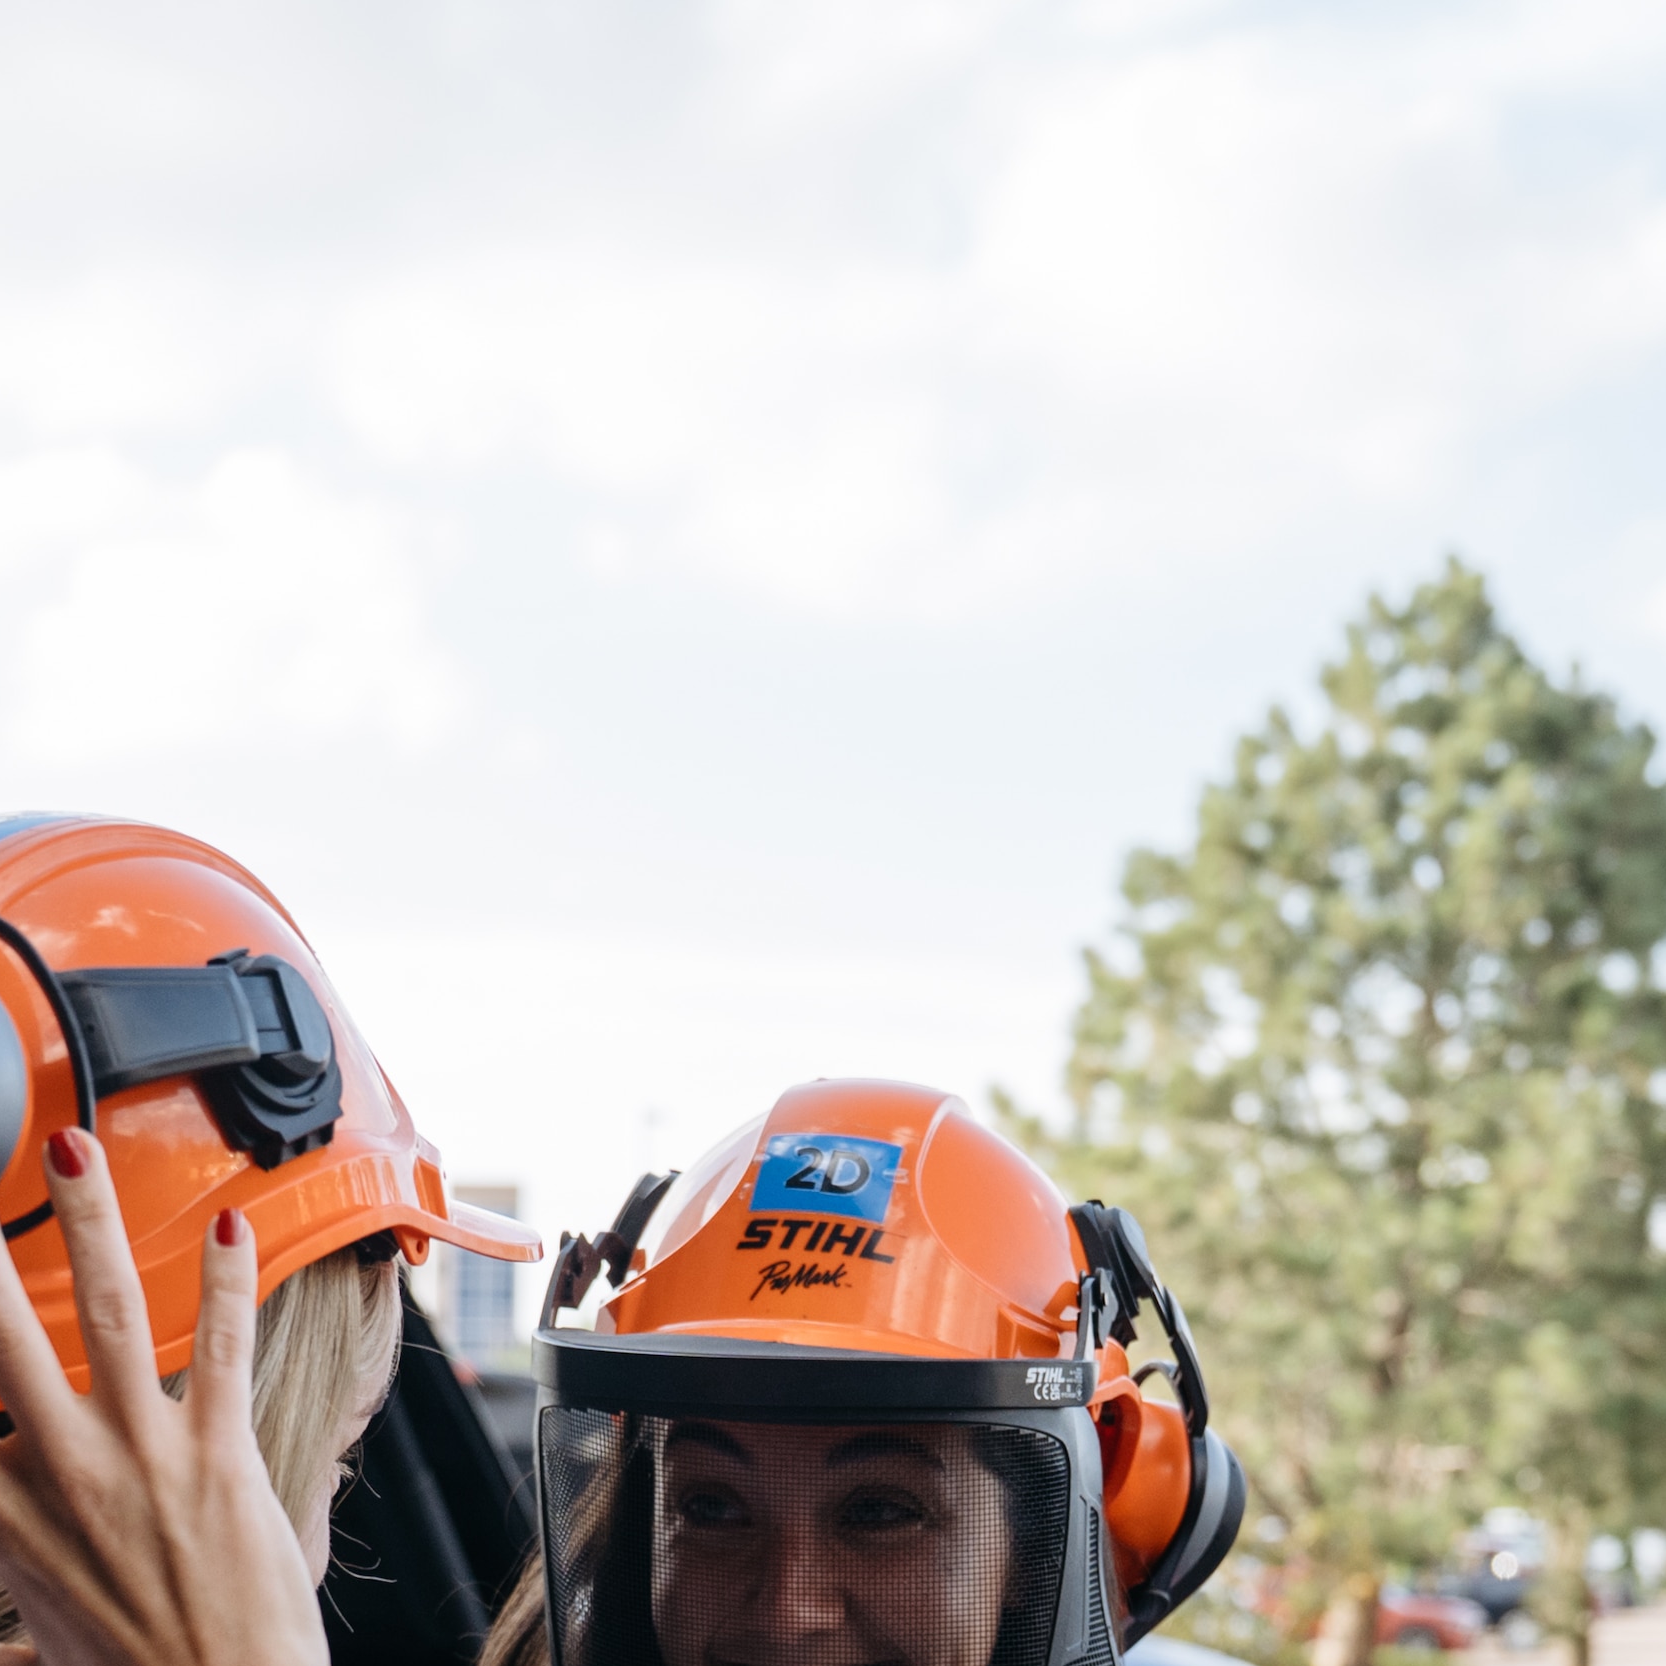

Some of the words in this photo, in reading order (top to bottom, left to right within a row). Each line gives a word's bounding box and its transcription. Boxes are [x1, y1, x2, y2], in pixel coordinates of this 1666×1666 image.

[785, 1147, 871, 1194] 2D
[737, 1219, 895, 1263] STIHL
[1025, 1367, 1065, 1384] STIHL
